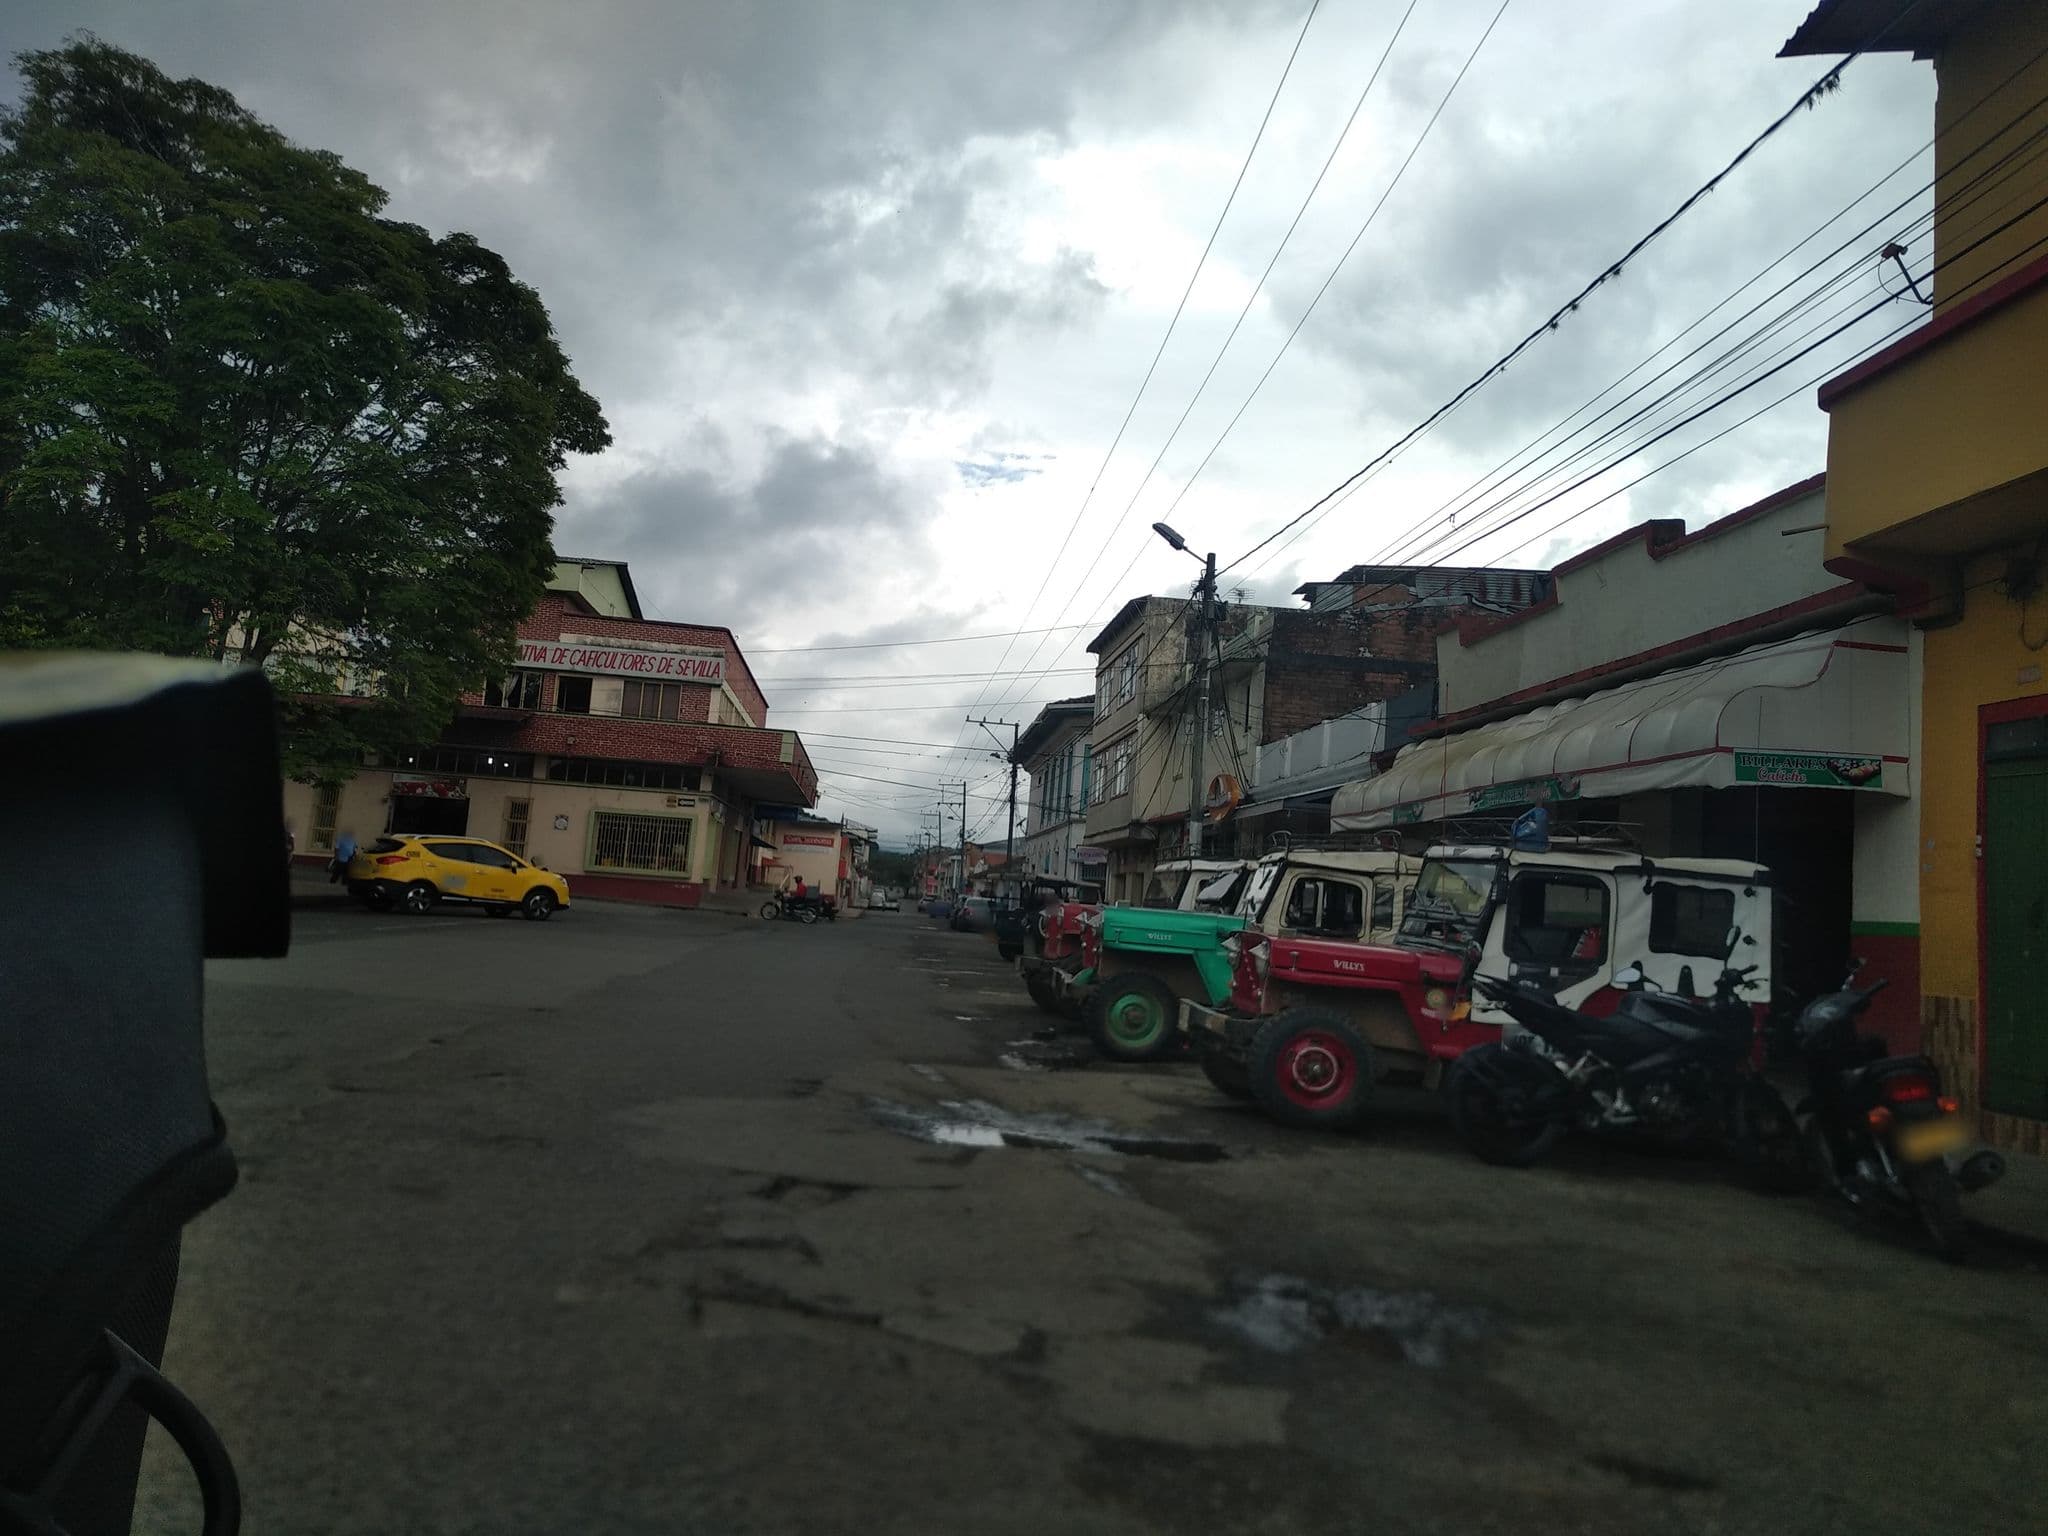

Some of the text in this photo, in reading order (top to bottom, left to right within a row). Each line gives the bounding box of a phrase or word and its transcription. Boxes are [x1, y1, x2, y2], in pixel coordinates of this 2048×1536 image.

[551, 647, 569, 665] DE
[569, 648, 655, 674] CAFICULTORES
[656, 657, 674, 675] DE
[675, 658, 721, 680] SEVILLA
[1741, 754, 1828, 771] BILLARES
[1333, 959, 1365, 972] WILLYS
